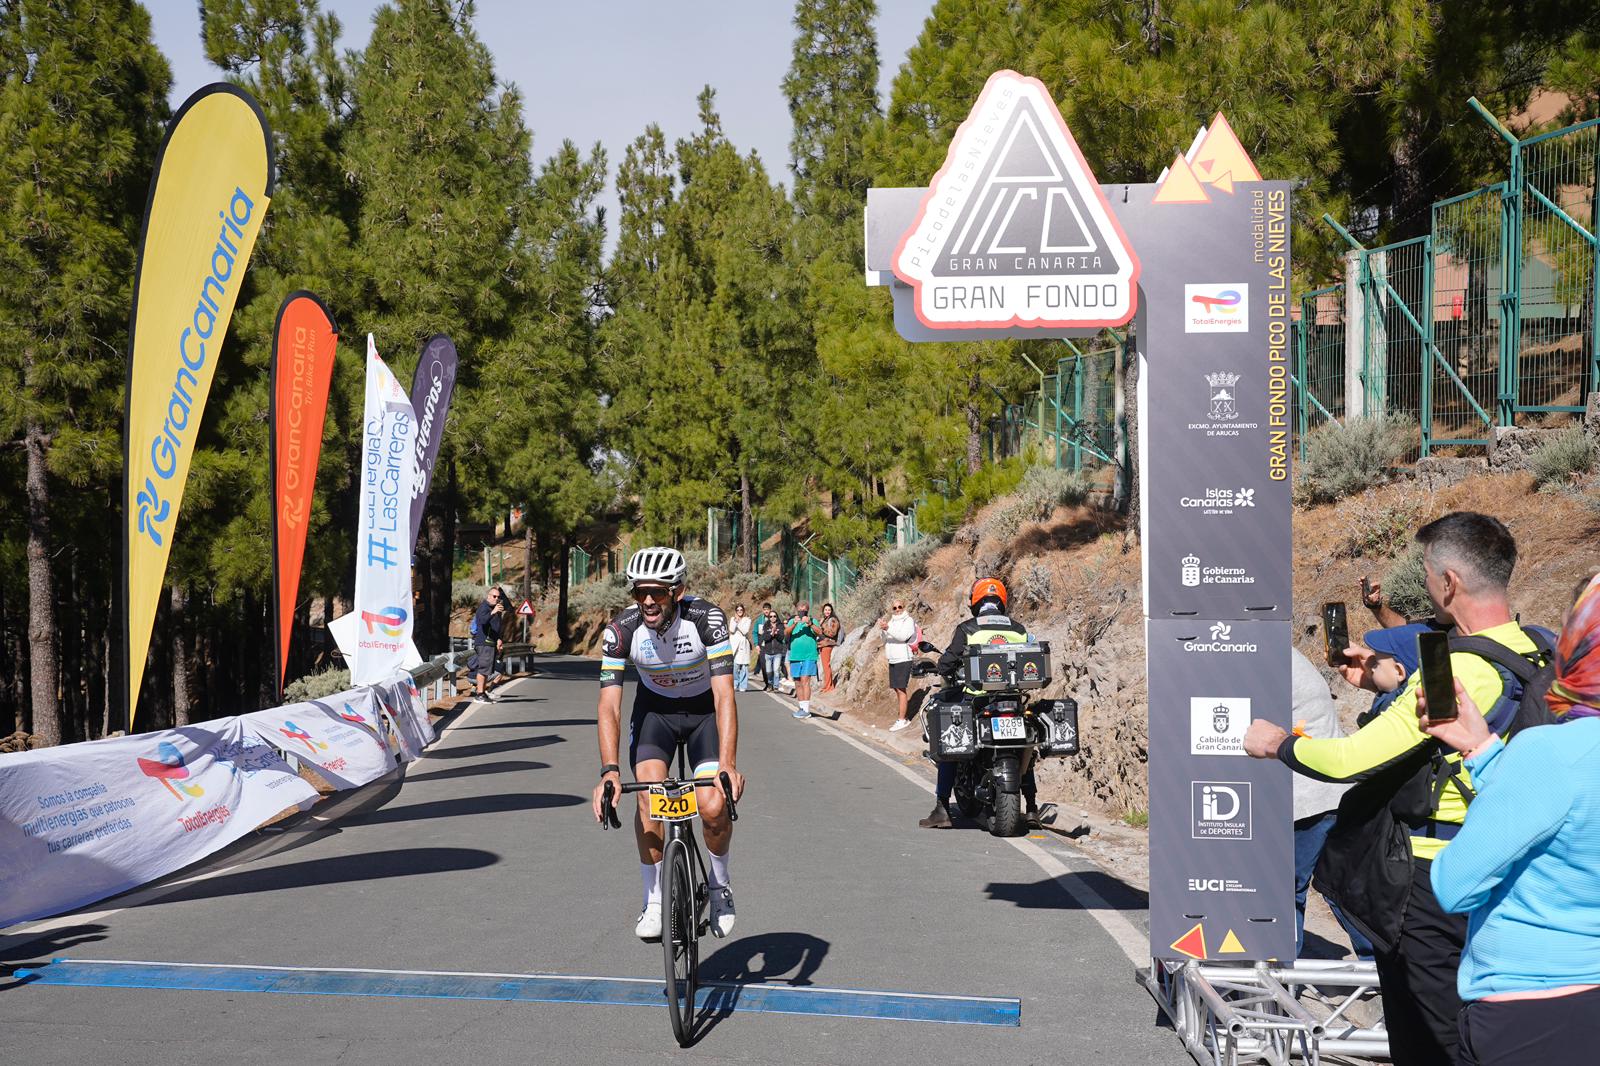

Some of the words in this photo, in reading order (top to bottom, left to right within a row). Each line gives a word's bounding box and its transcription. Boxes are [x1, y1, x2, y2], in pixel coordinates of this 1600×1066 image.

[1251, 190, 1264, 262] modalidad
[1268, 190, 1285, 252] NIEVES
[950, 258, 998, 270] GRAN
[1014, 256, 1101, 269] CANARIA
[1268, 256, 1286, 290] LAS
[934, 285, 1005, 309] GRAN
[1027, 284, 1117, 308] FONDO
[1268, 293, 1286, 317] DE
[151, 186, 254, 480] GranCanaria
[1192, 318, 1242, 326] TotalEnergies
[1268, 321, 1286, 361] PICO
[1269, 365, 1286, 426] FONDO
[285, 326, 306, 490] GranCanaria
[416, 376, 443, 461] EVENTOS
[1269, 431, 1287, 481] GRAN
[379, 412, 410, 531] LasCarreras
[1180, 497, 1233, 507] Canarias
[1206, 488, 1233, 498] Islas
[1203, 567, 1245, 575] Gobierno
[1203, 576, 1214, 584] de
[1215, 576, 1255, 584] Canarias
[1184, 641, 1257, 652] GranCanaria
[1000, 728, 1018, 737] KHZ
[1196, 743, 1215, 751] Gran
[37, 794, 66, 809] Somos
[64, 790, 74, 803] la
[90, 806, 103, 818] que
[103, 797, 136, 815] patrocina
[659, 798, 689, 813] 240
[178, 803, 231, 832] TotalEnergies
[47, 841, 61, 854] tus
[62, 829, 94, 849] carreras
[95, 818, 133, 840] preferidas
